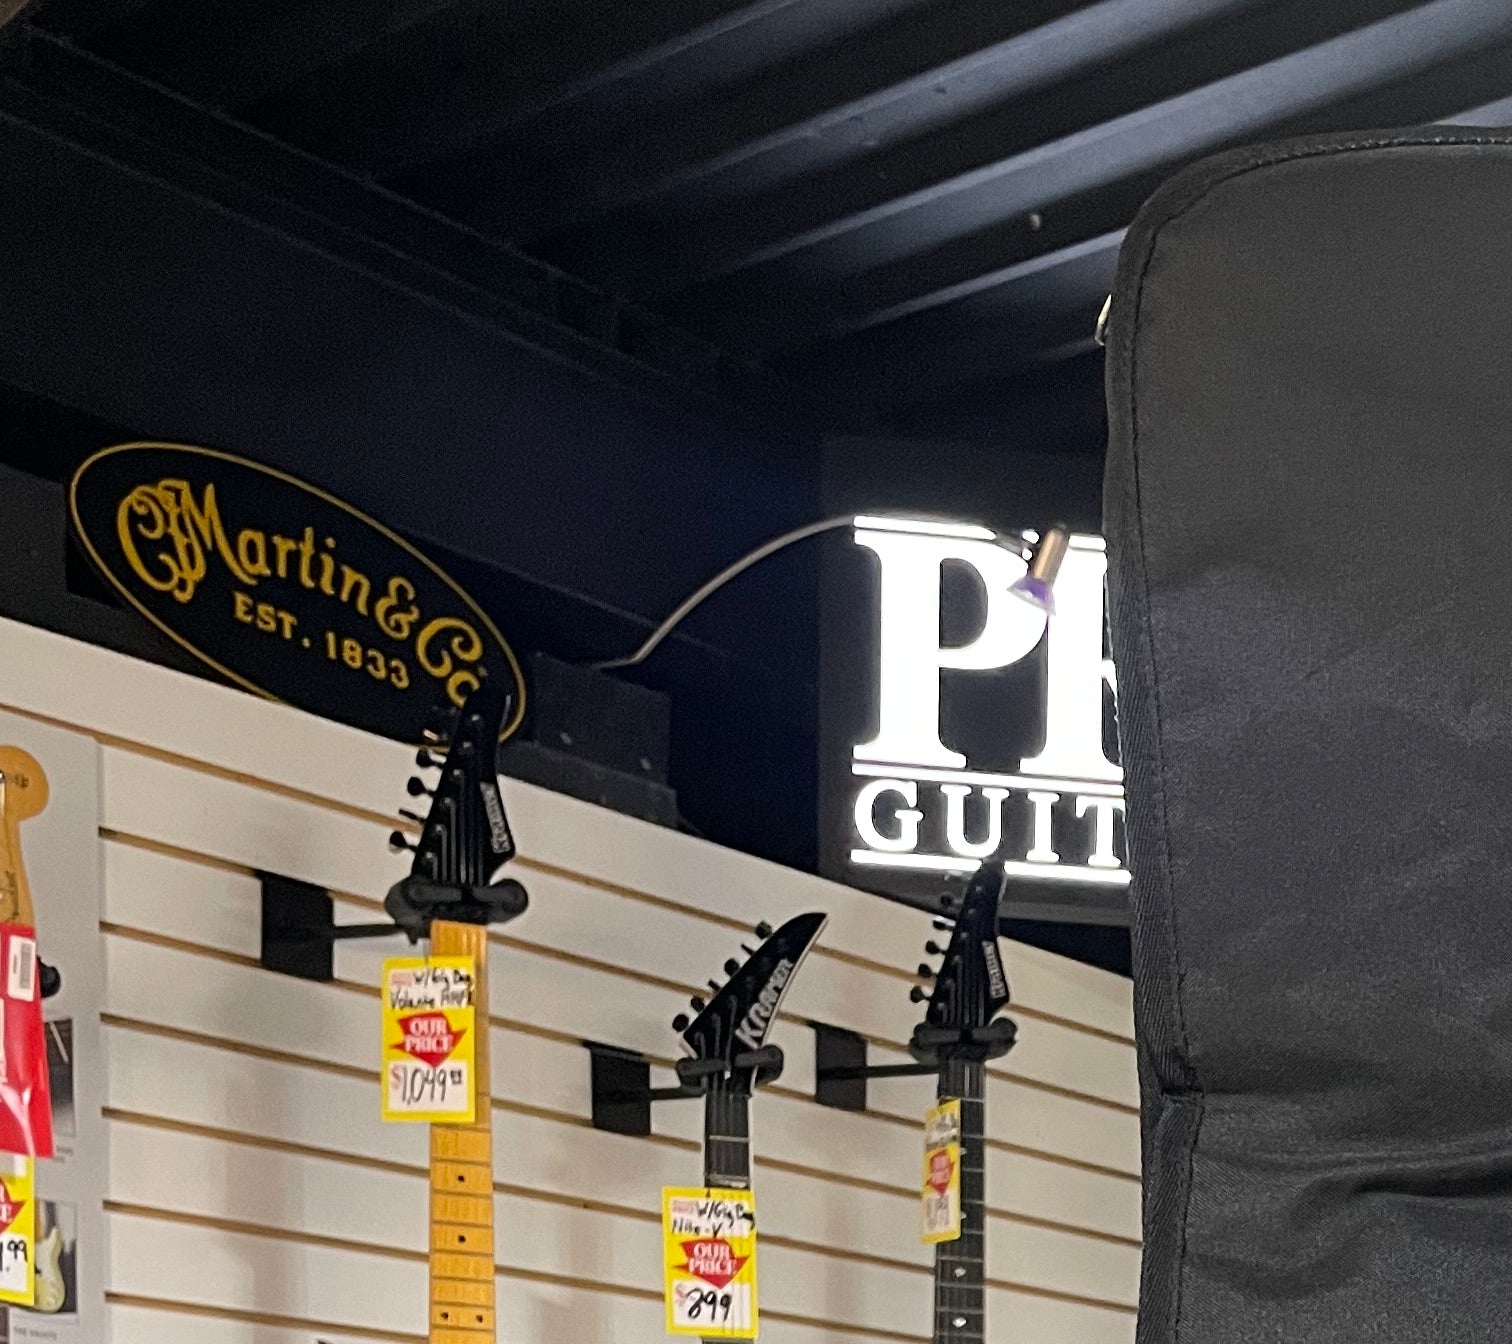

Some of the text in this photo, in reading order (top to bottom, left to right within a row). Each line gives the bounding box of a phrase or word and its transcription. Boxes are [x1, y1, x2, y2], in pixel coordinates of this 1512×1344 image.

[233, 591, 411, 689] EST. 1833
[409, 1017, 448, 1035] OUR
[693, 1243, 731, 1258] OUR
[688, 1257, 737, 1276] PRICE
